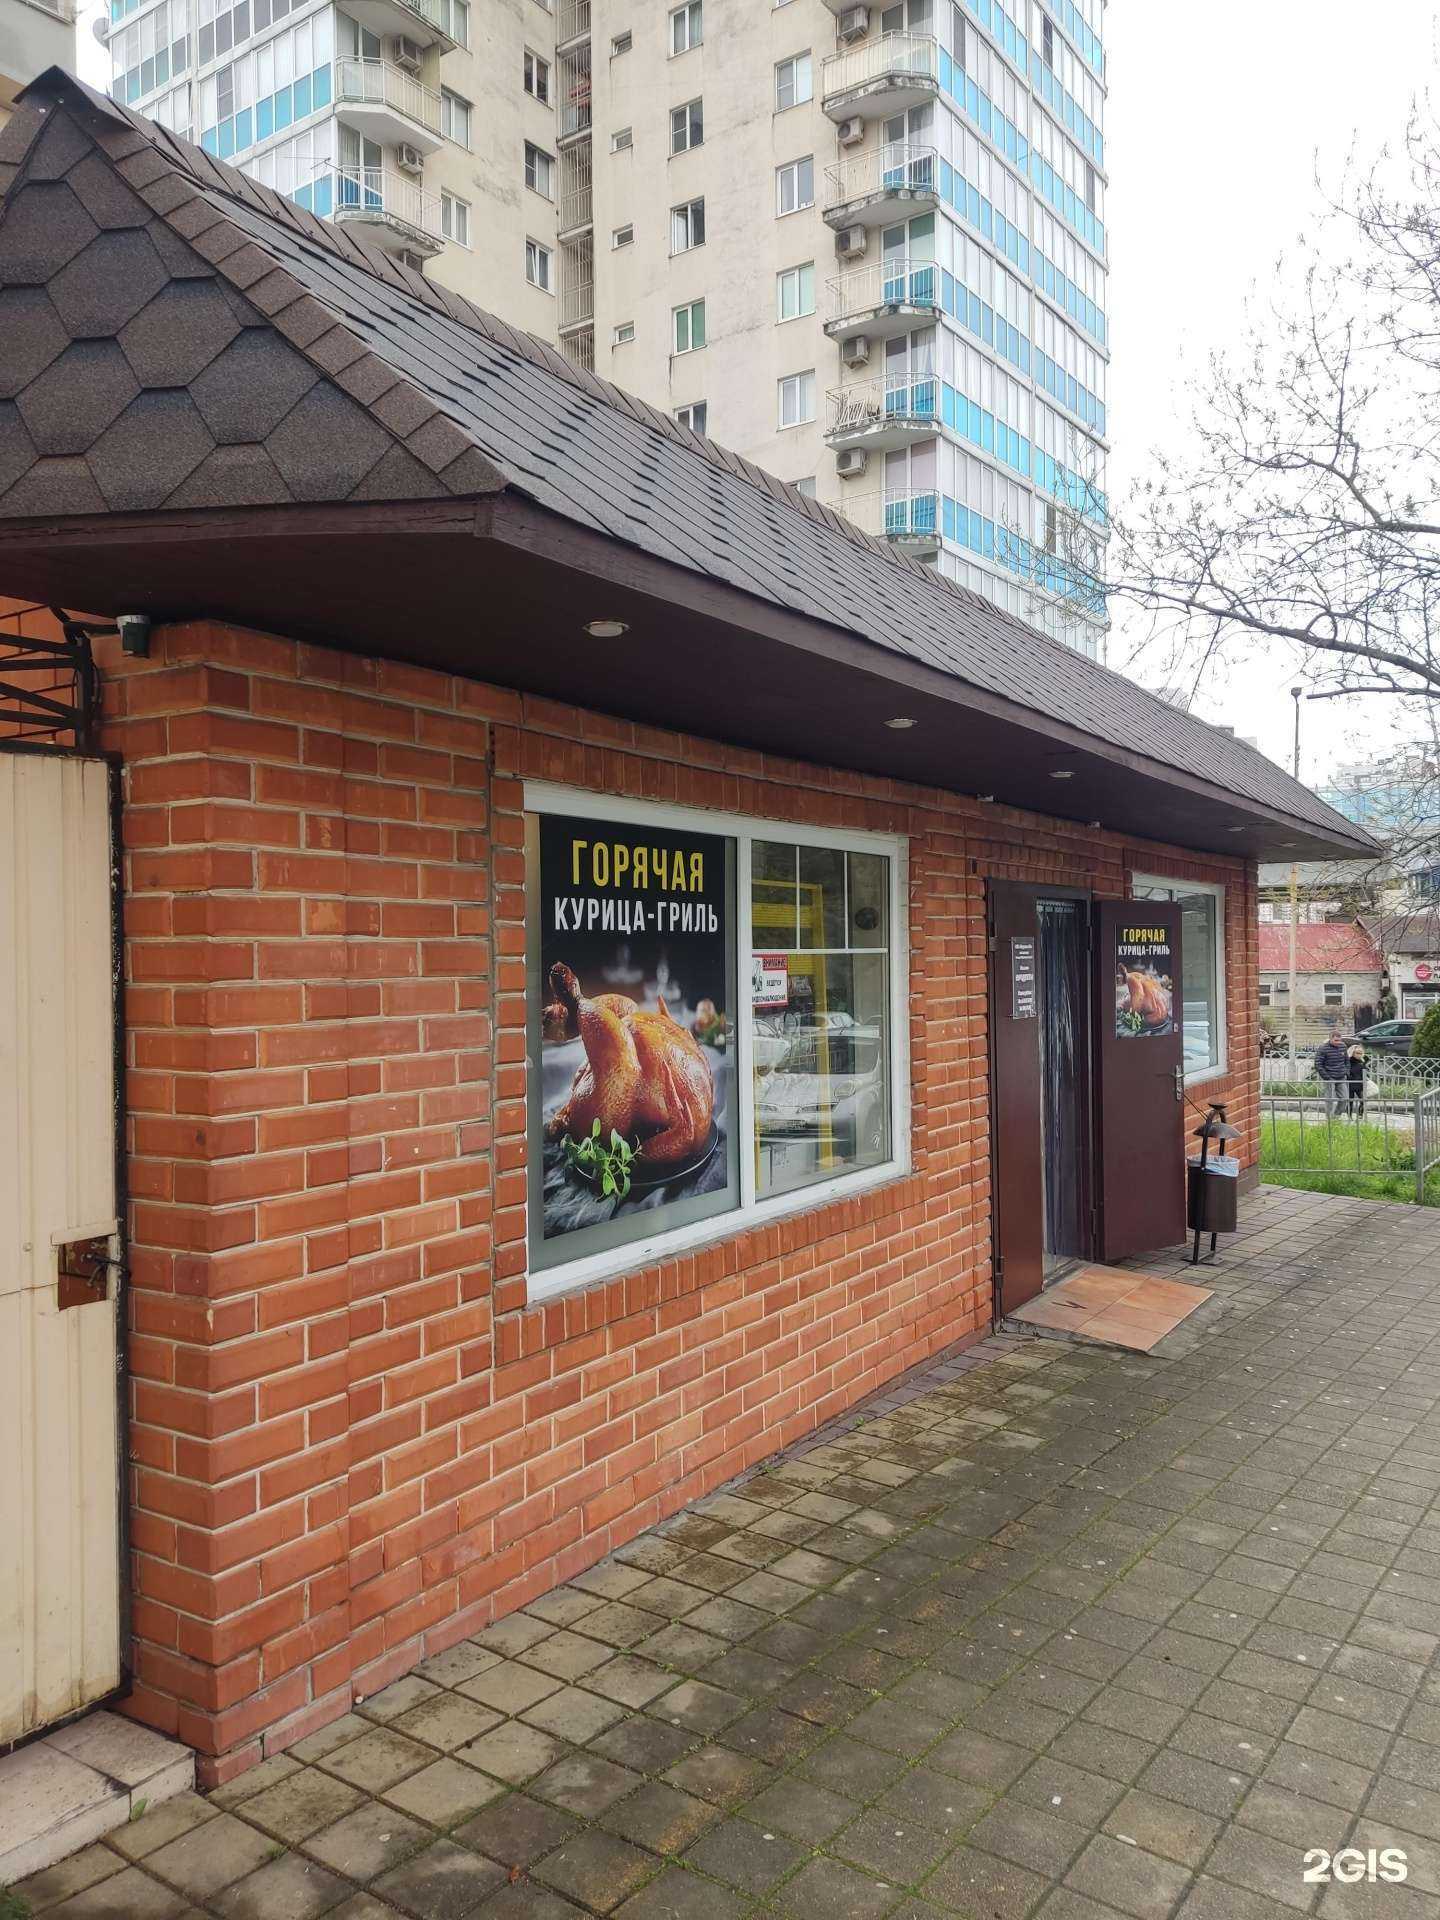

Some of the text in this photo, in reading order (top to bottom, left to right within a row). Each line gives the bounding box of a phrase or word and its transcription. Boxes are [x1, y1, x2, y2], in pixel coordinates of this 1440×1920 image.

[572, 839, 704, 893] ГОРЯЧАЯ
[554, 897, 719, 935] КУРИЦА-ГРИЛЬ
[1123, 928, 1166, 943] ГОРЯЧАЯ
[1118, 945, 1171, 956] КУРИЦА-ГРИЛЬ
